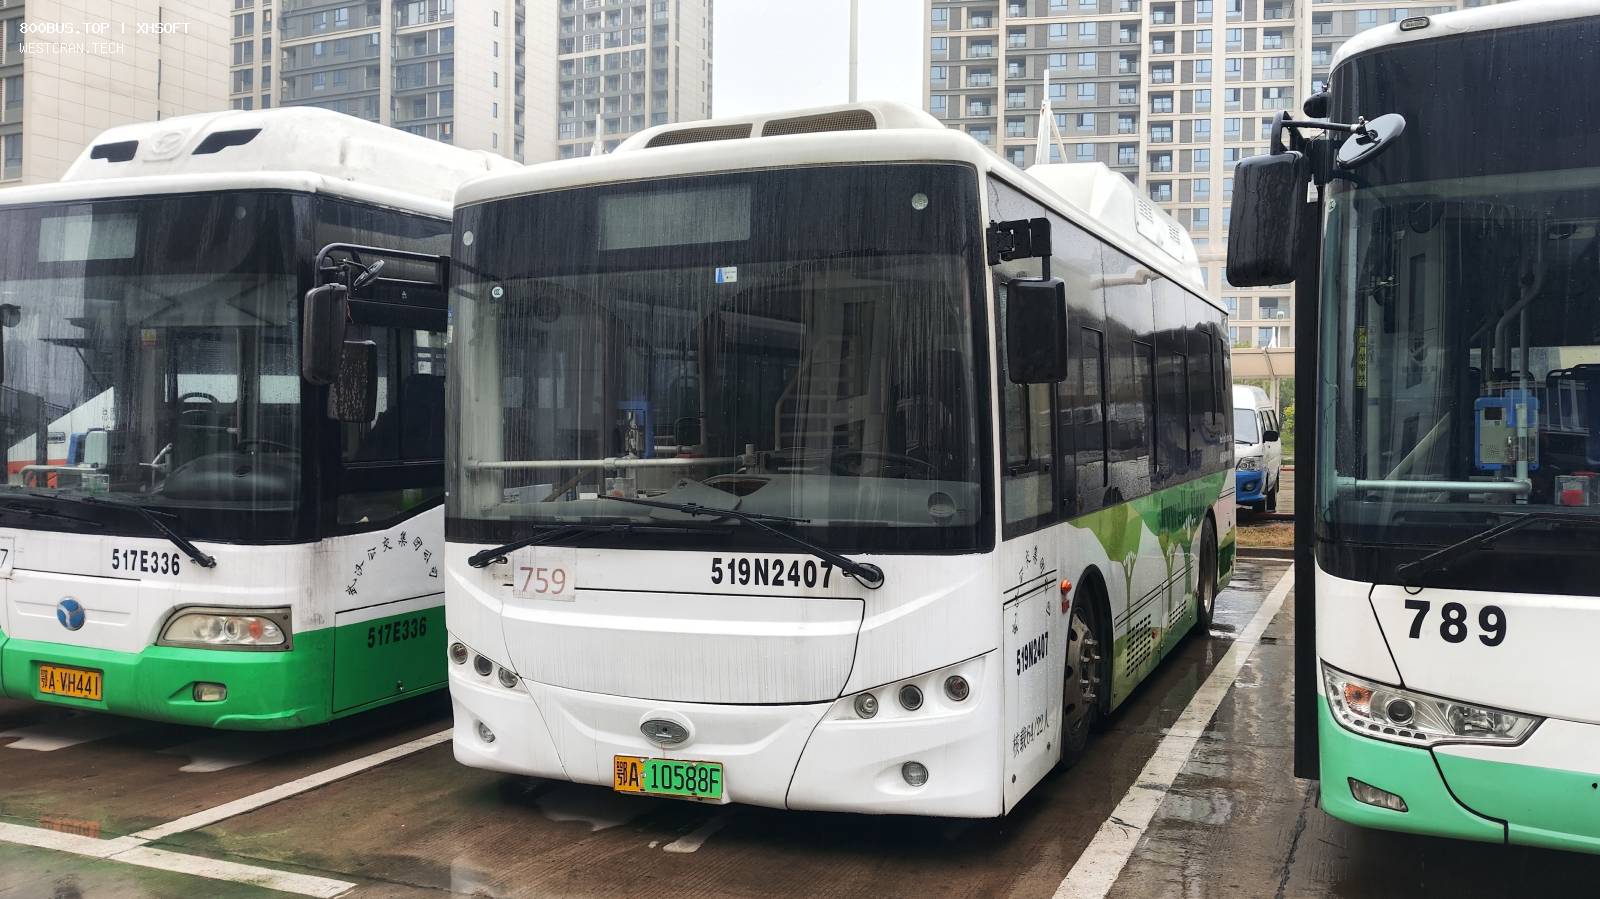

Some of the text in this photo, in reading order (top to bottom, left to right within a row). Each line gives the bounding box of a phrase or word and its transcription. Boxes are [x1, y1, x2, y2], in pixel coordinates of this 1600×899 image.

[112, 549, 180, 575] 517E336
[711, 557, 832, 588] 519N2407
[520, 566, 566, 594] 759
[367, 616, 427, 649] 517E336
[1404, 599, 1507, 647] 789
[1016, 631, 1049, 676] 519N2407
